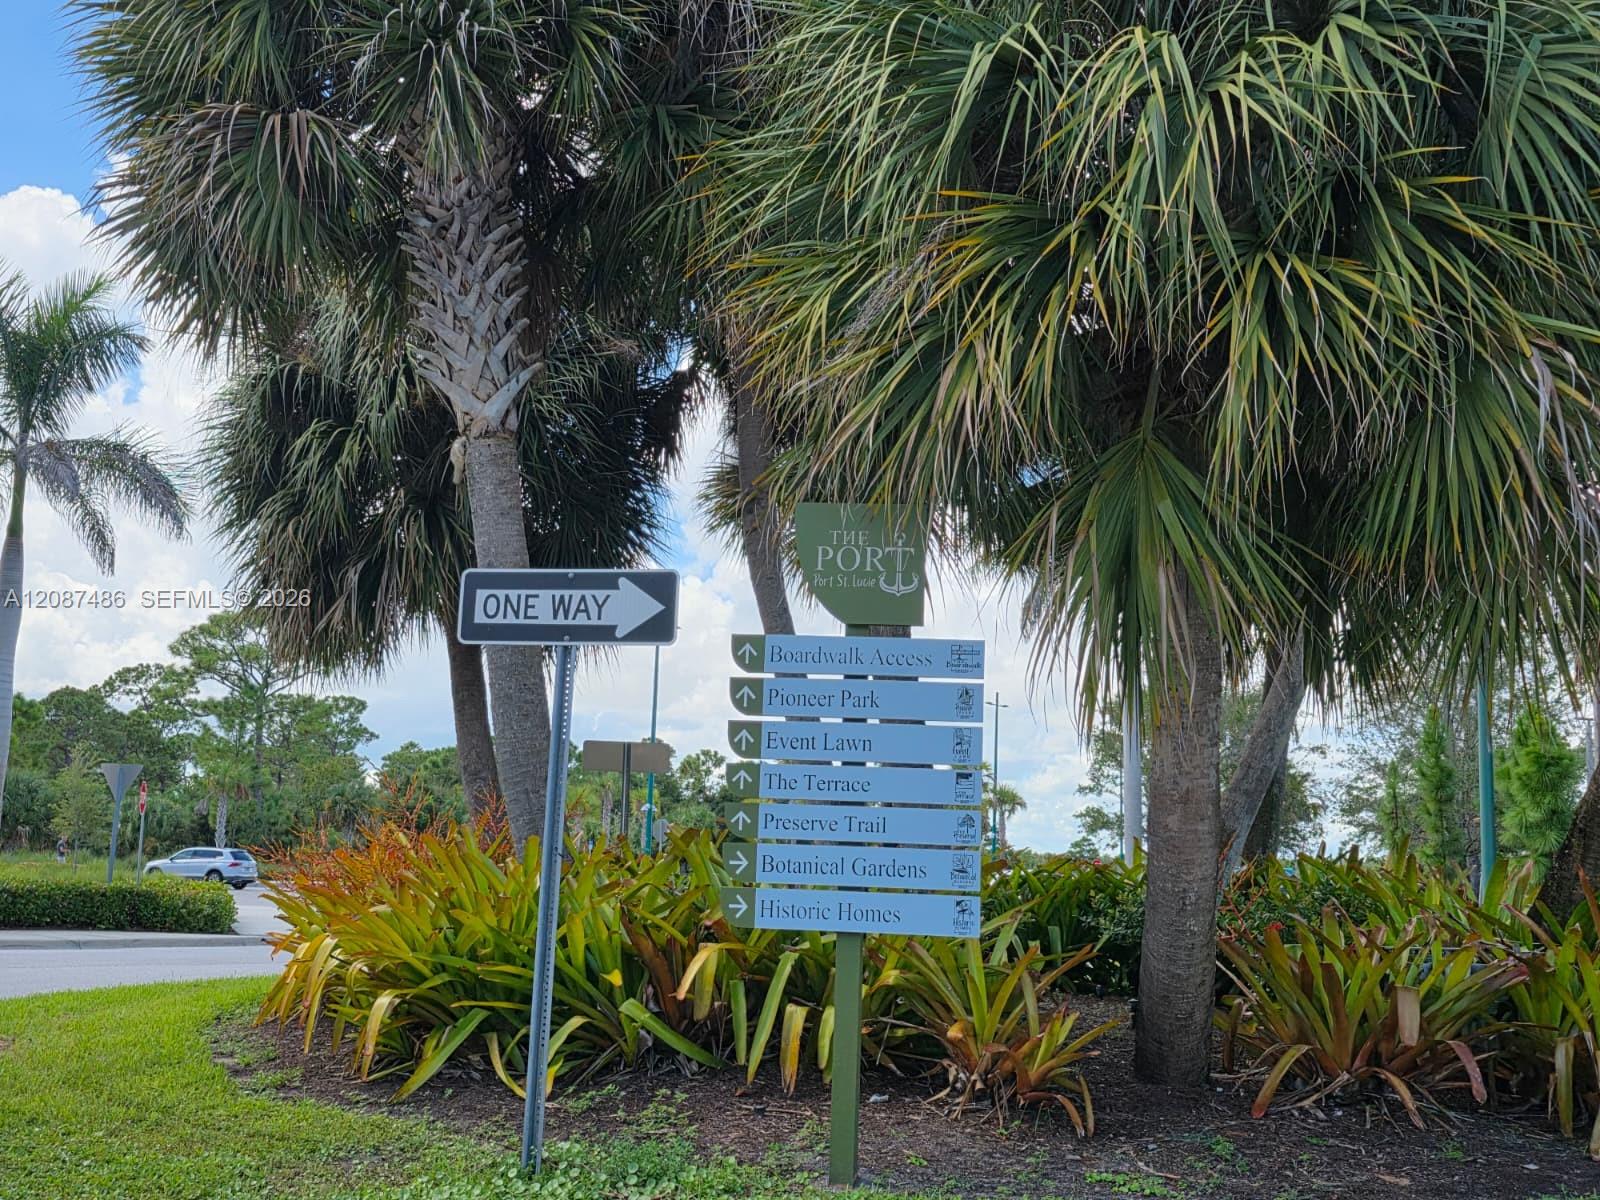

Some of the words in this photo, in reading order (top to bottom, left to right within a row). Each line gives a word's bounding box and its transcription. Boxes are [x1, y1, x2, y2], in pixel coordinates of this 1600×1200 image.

[829, 530, 870, 546] THE
[814, 573, 833, 588] Port
[837, 573, 850, 588] St.
[852, 574, 877, 588] Lucie
[483, 593, 540, 621] ONE
[551, 593, 612, 621] WAY
[770, 644, 864, 666] Boardwalk
[870, 647, 934, 668] Access
[767, 687, 836, 708] Pioneer
[840, 689, 880, 709] Park
[766, 730, 817, 751] Event
[823, 732, 873, 752] Lawn
[764, 772, 799, 790] The
[804, 774, 872, 793] Terrace
[763, 812, 839, 832] Preserve
[844, 815, 888, 834] Trail
[761, 854, 845, 875] Botanical
[851, 858, 928, 879] Gardens
[760, 899, 831, 920] Historic
[837, 902, 902, 923] Homes
